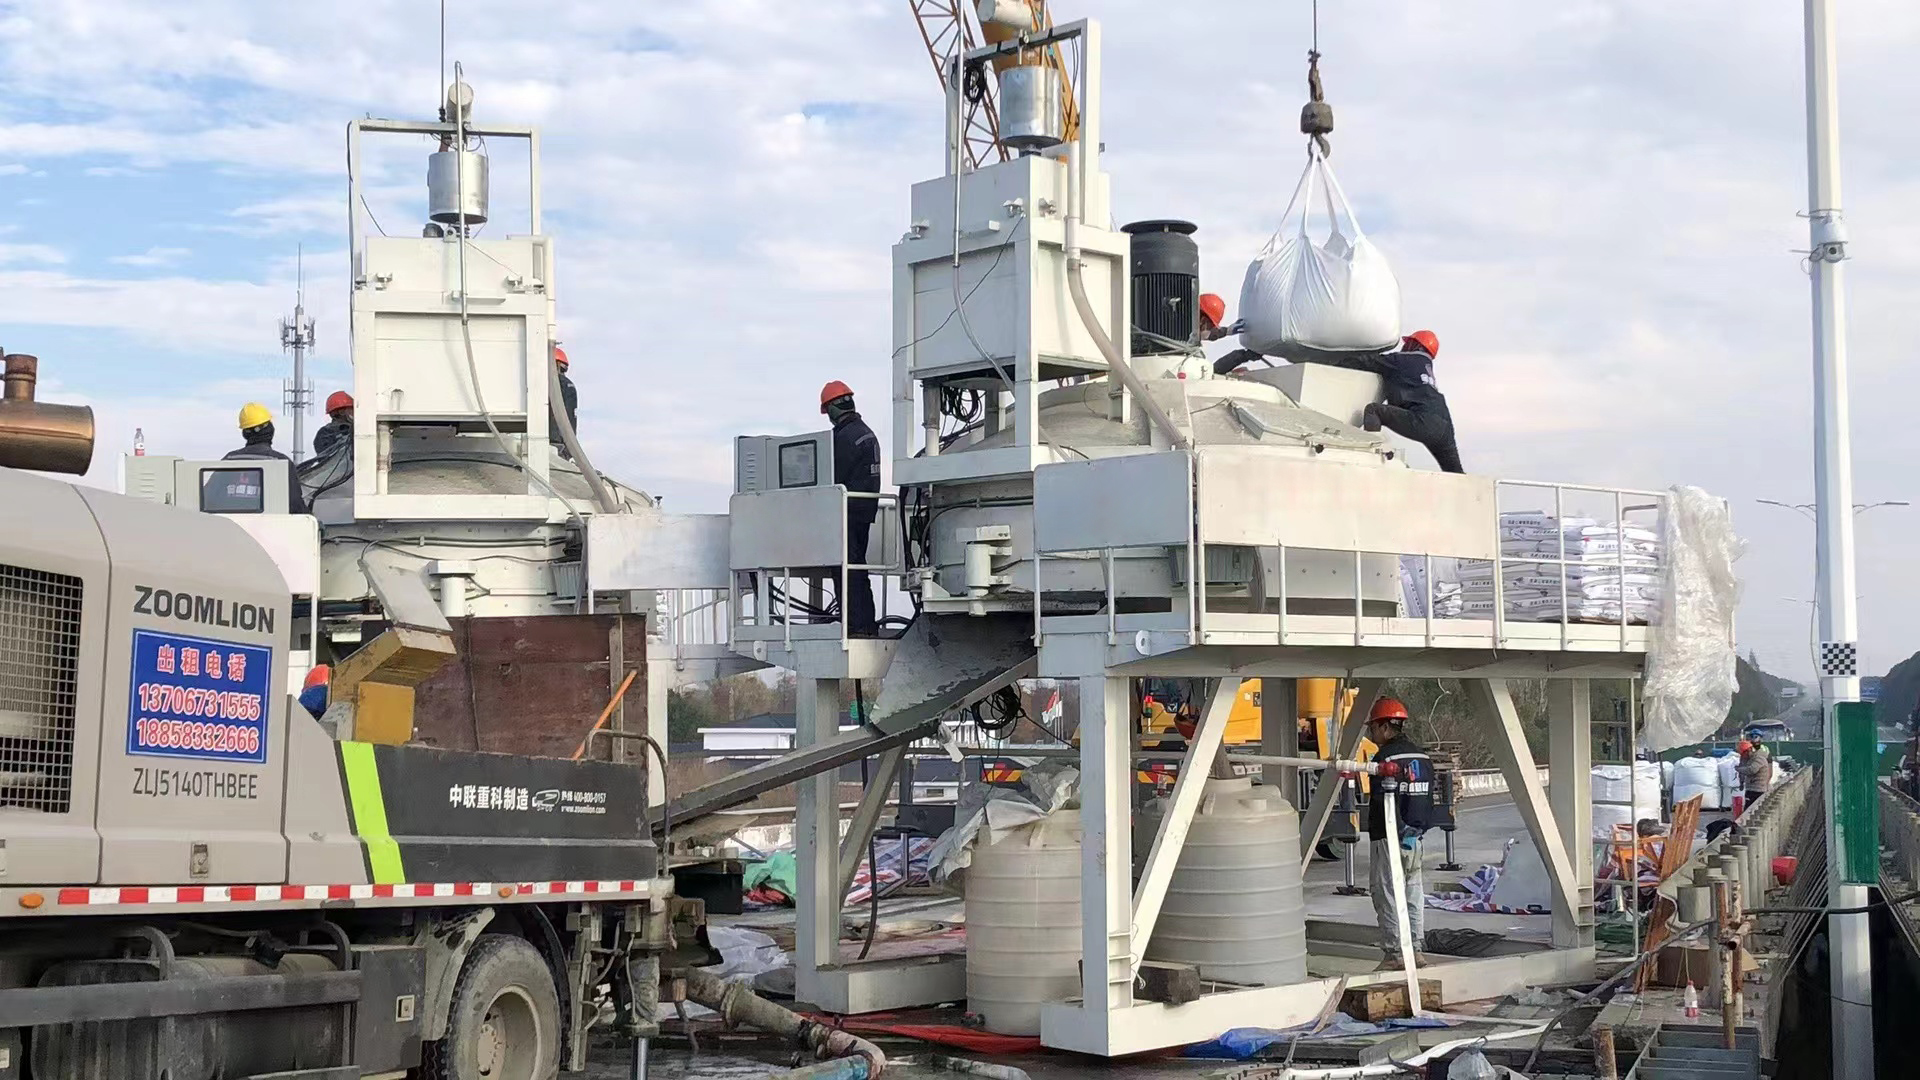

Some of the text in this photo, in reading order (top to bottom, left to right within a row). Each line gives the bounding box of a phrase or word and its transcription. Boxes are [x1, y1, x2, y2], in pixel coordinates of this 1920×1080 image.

[133, 585, 275, 634] ZOOMLION
[156, 644, 246, 682] 出租电话
[138, 683, 261, 721] 13706731555
[136, 718, 259, 753] 18858332666
[132, 767, 258, 799] ZLJ5140THBEE
[449, 783, 529, 811] 中联重科制造
